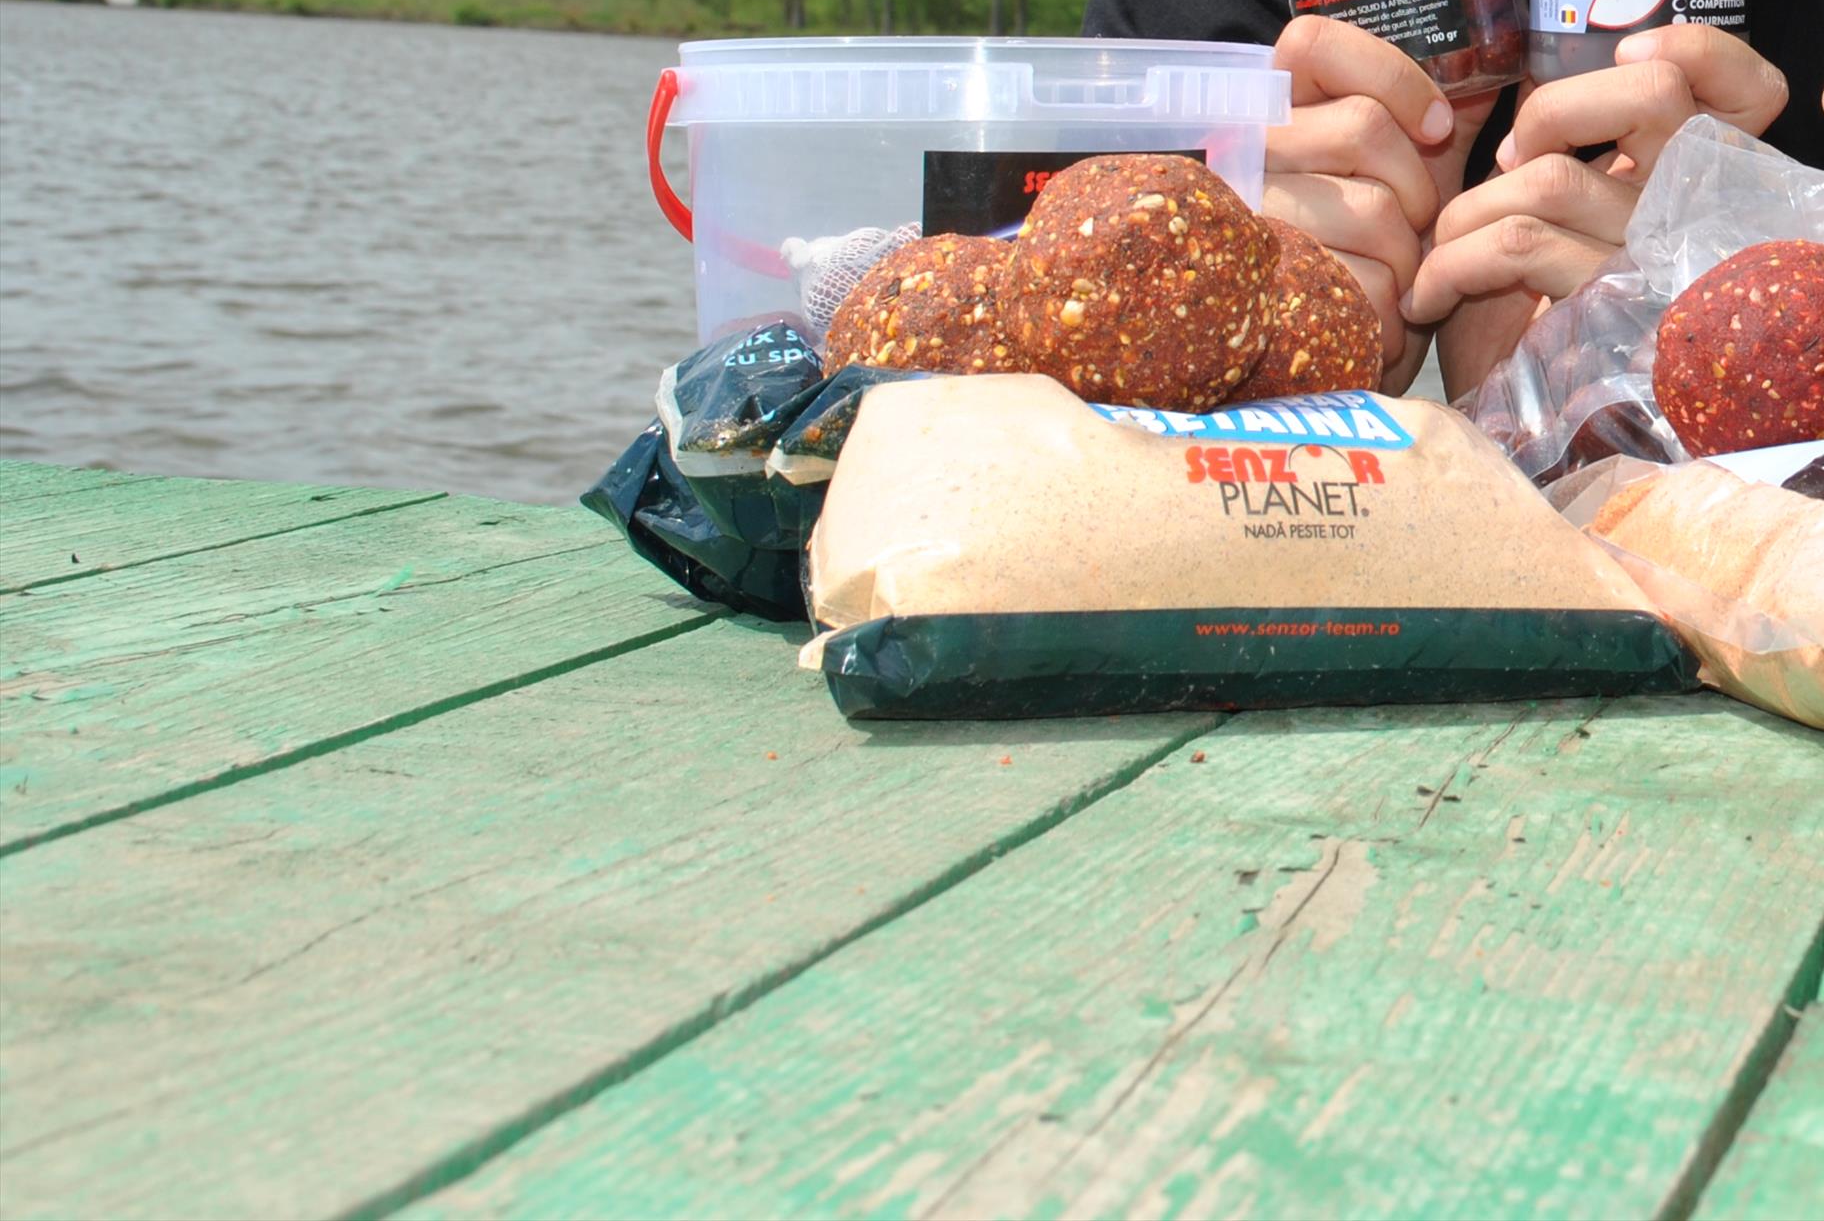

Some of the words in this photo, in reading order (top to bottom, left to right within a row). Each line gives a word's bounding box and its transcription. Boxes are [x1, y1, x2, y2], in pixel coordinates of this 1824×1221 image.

[1690, 14, 1746, 26] TOURNAMENT
[1425, 32, 1446, 45] 100
[1446, 29, 1459, 42] gr
[724, 352, 756, 367] cu
[1185, 443, 1386, 484] SENZOR
[1218, 481, 1360, 516] PLANET
[1244, 521, 1286, 539] NADĂ
[1290, 524, 1326, 539] PESTE
[1329, 524, 1356, 539] TOT
[1195, 619, 1400, 636] www.senzor-team.ro
